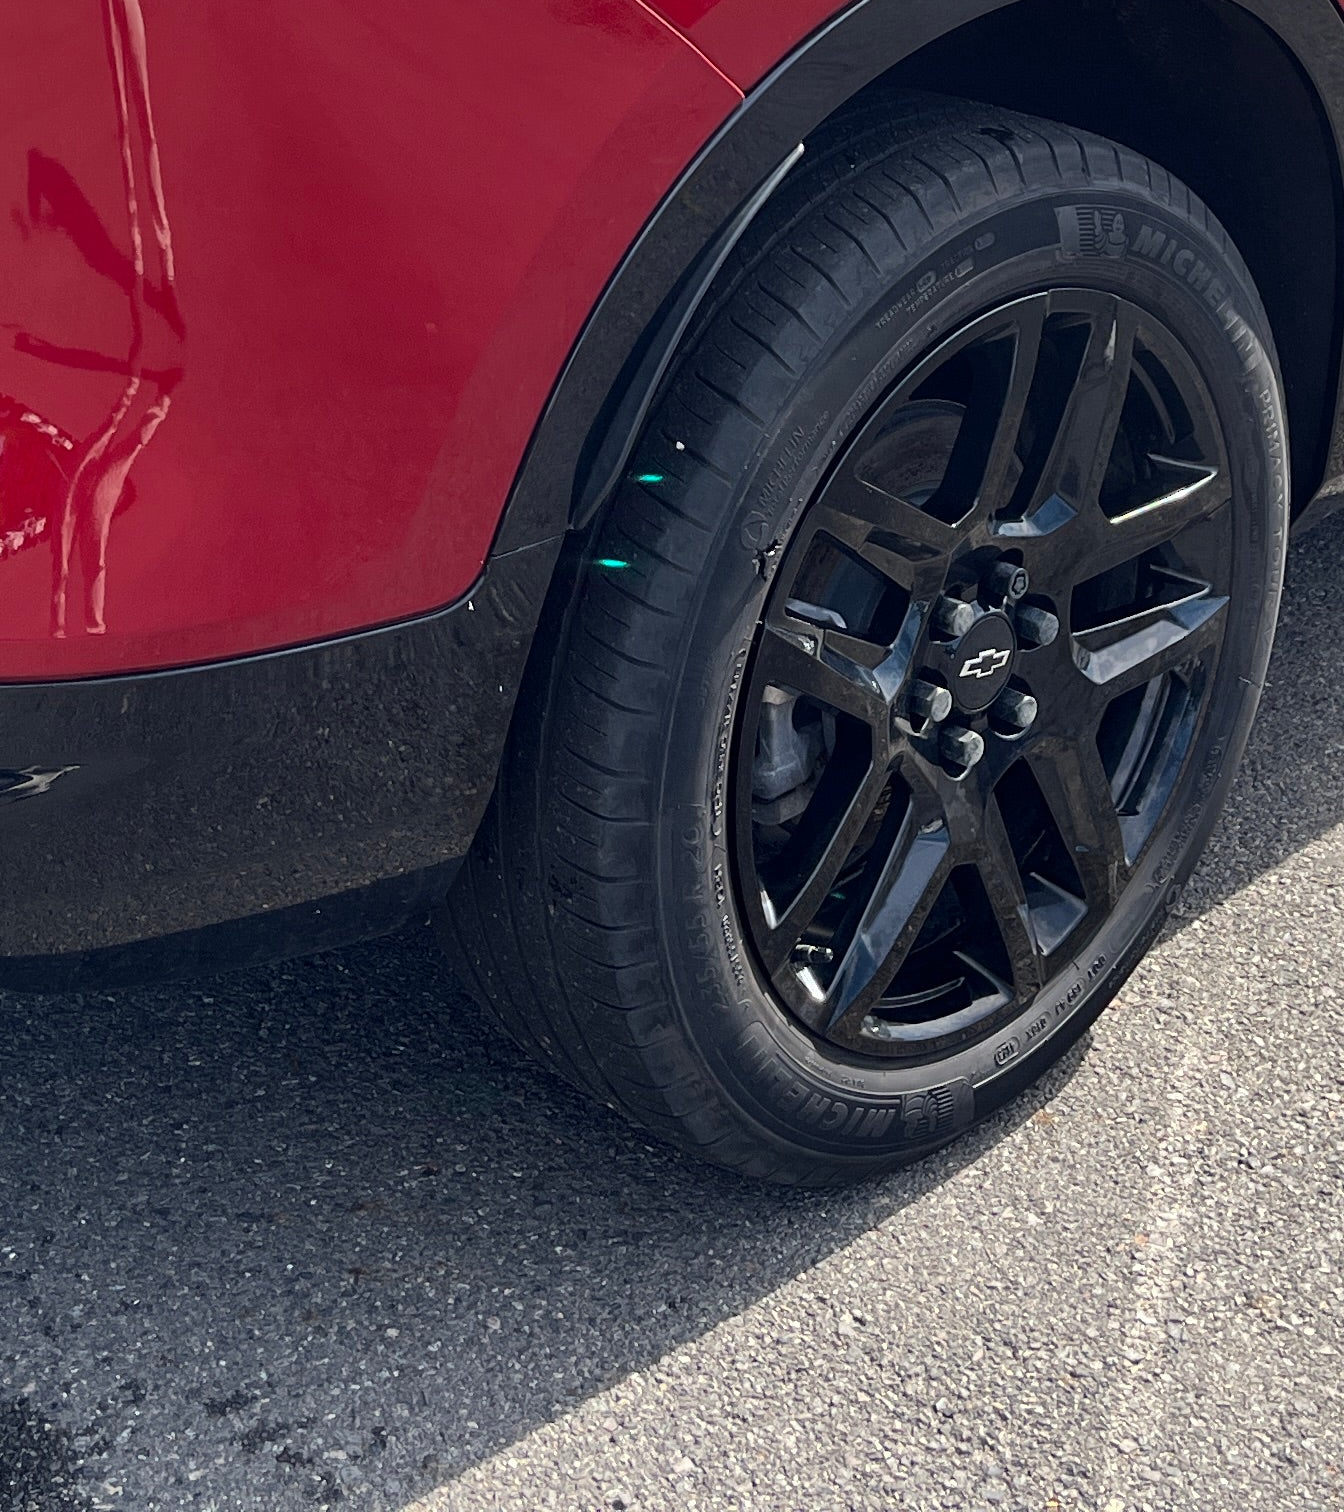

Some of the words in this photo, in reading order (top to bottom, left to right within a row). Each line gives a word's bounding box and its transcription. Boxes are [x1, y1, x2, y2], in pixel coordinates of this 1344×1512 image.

[1131, 224, 1259, 376] MICHELIN
[1258, 389, 1285, 510] PRIMACY
[1266, 525, 1284, 609] TOUR
[742, 1029, 897, 1138] MICHELIN
